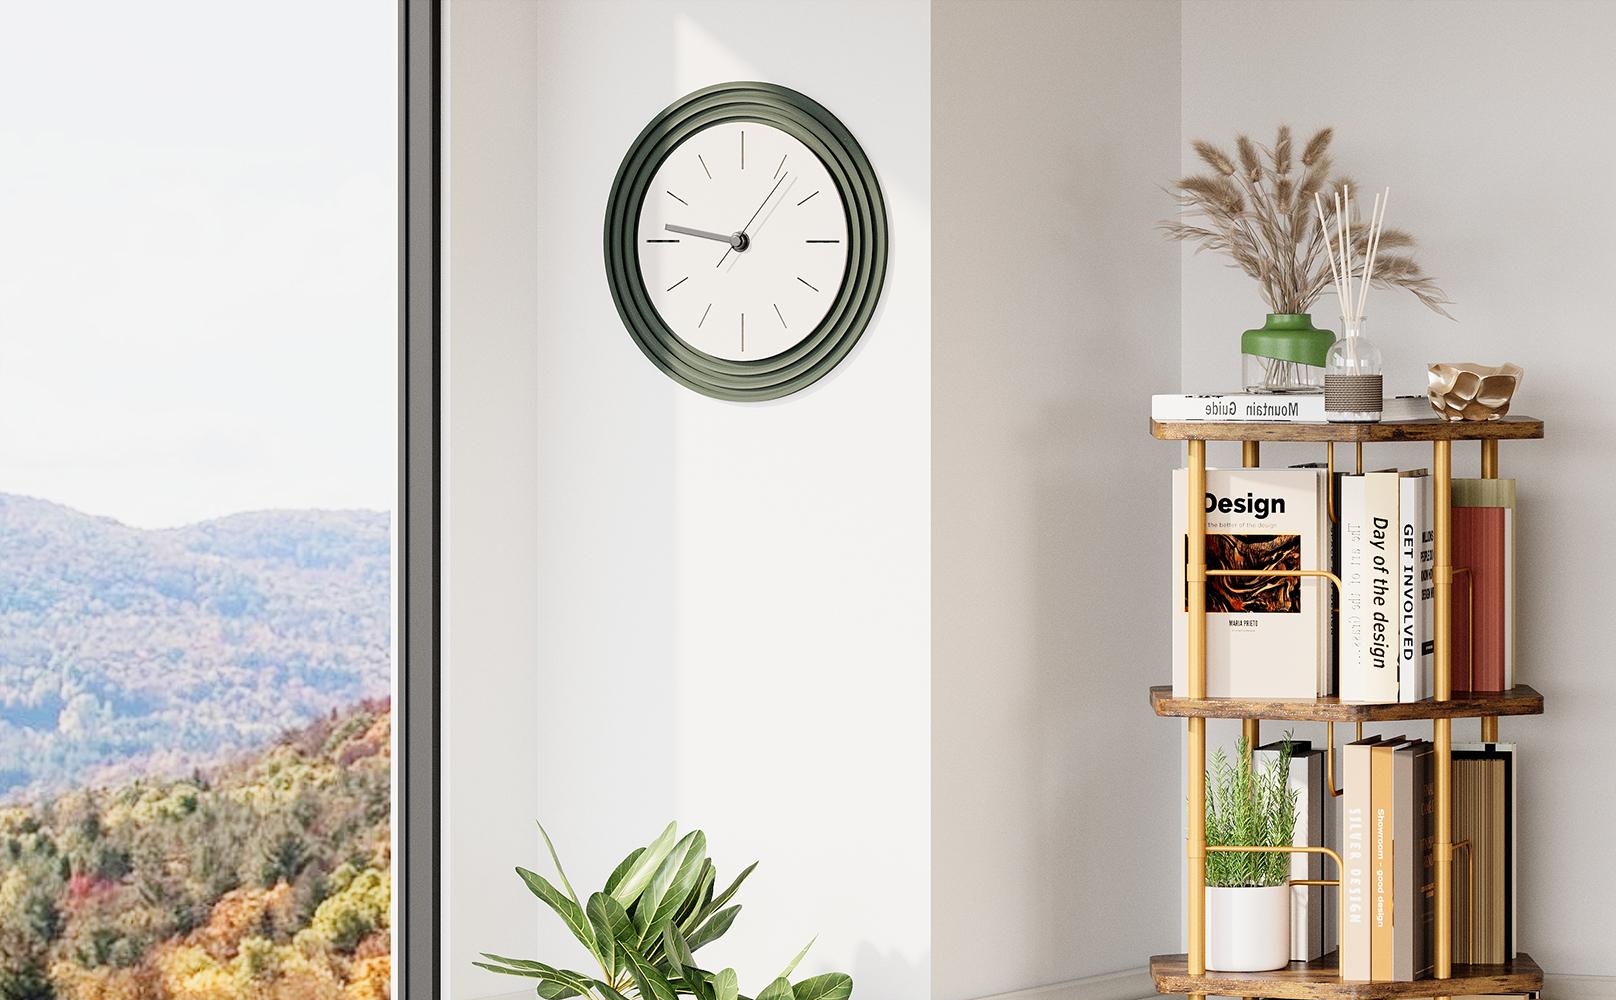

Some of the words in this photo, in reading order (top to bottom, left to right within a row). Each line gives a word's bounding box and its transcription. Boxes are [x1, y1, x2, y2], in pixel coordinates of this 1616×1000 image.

[1205, 492, 1285, 520] Design
[1370, 517, 1388, 550] Day
[1403, 524, 1414, 558] GET
[1373, 556, 1389, 575] of
[1373, 580, 1389, 606] the
[1403, 566, 1414, 660] INVOLVED
[1370, 615, 1389, 669] design
[1349, 808, 1362, 860] SILVER
[1376, 808, 1385, 860] Showroom
[1349, 868, 1362, 924] DESIGN
[1376, 869, 1385, 893] good
[1376, 895, 1385, 928] design
